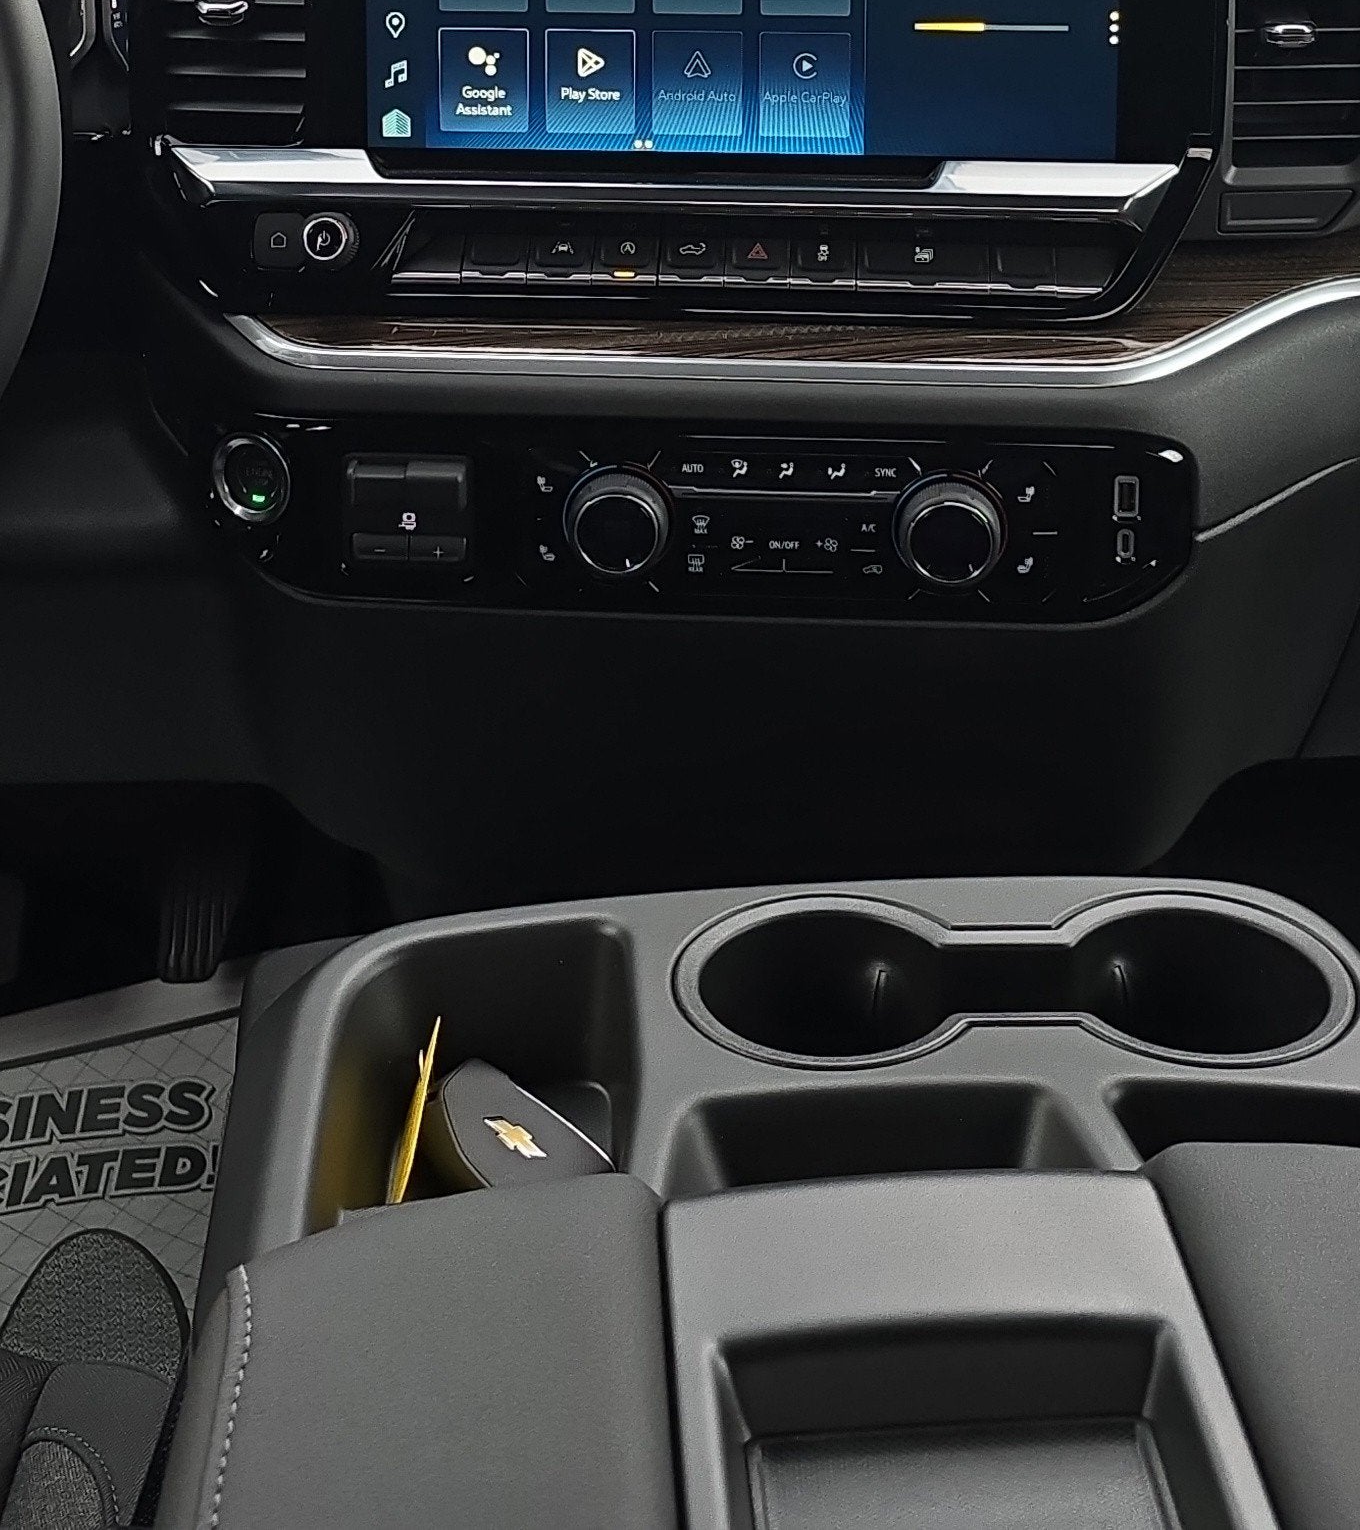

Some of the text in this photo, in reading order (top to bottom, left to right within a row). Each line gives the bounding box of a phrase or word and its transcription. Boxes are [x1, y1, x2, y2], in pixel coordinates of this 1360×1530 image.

[462, 86, 506, 102] Google
[560, 87, 620, 103] Play Store
[658, 89, 736, 103] Android Auto
[762, 91, 847, 107] Apple CarPlay
[455, 103, 513, 117] Assistant
[682, 462, 704, 473] AUTO
[875, 467, 897, 478] SYNC
[861, 522, 876, 533] A/C
[769, 539, 800, 550] ON/OFF
